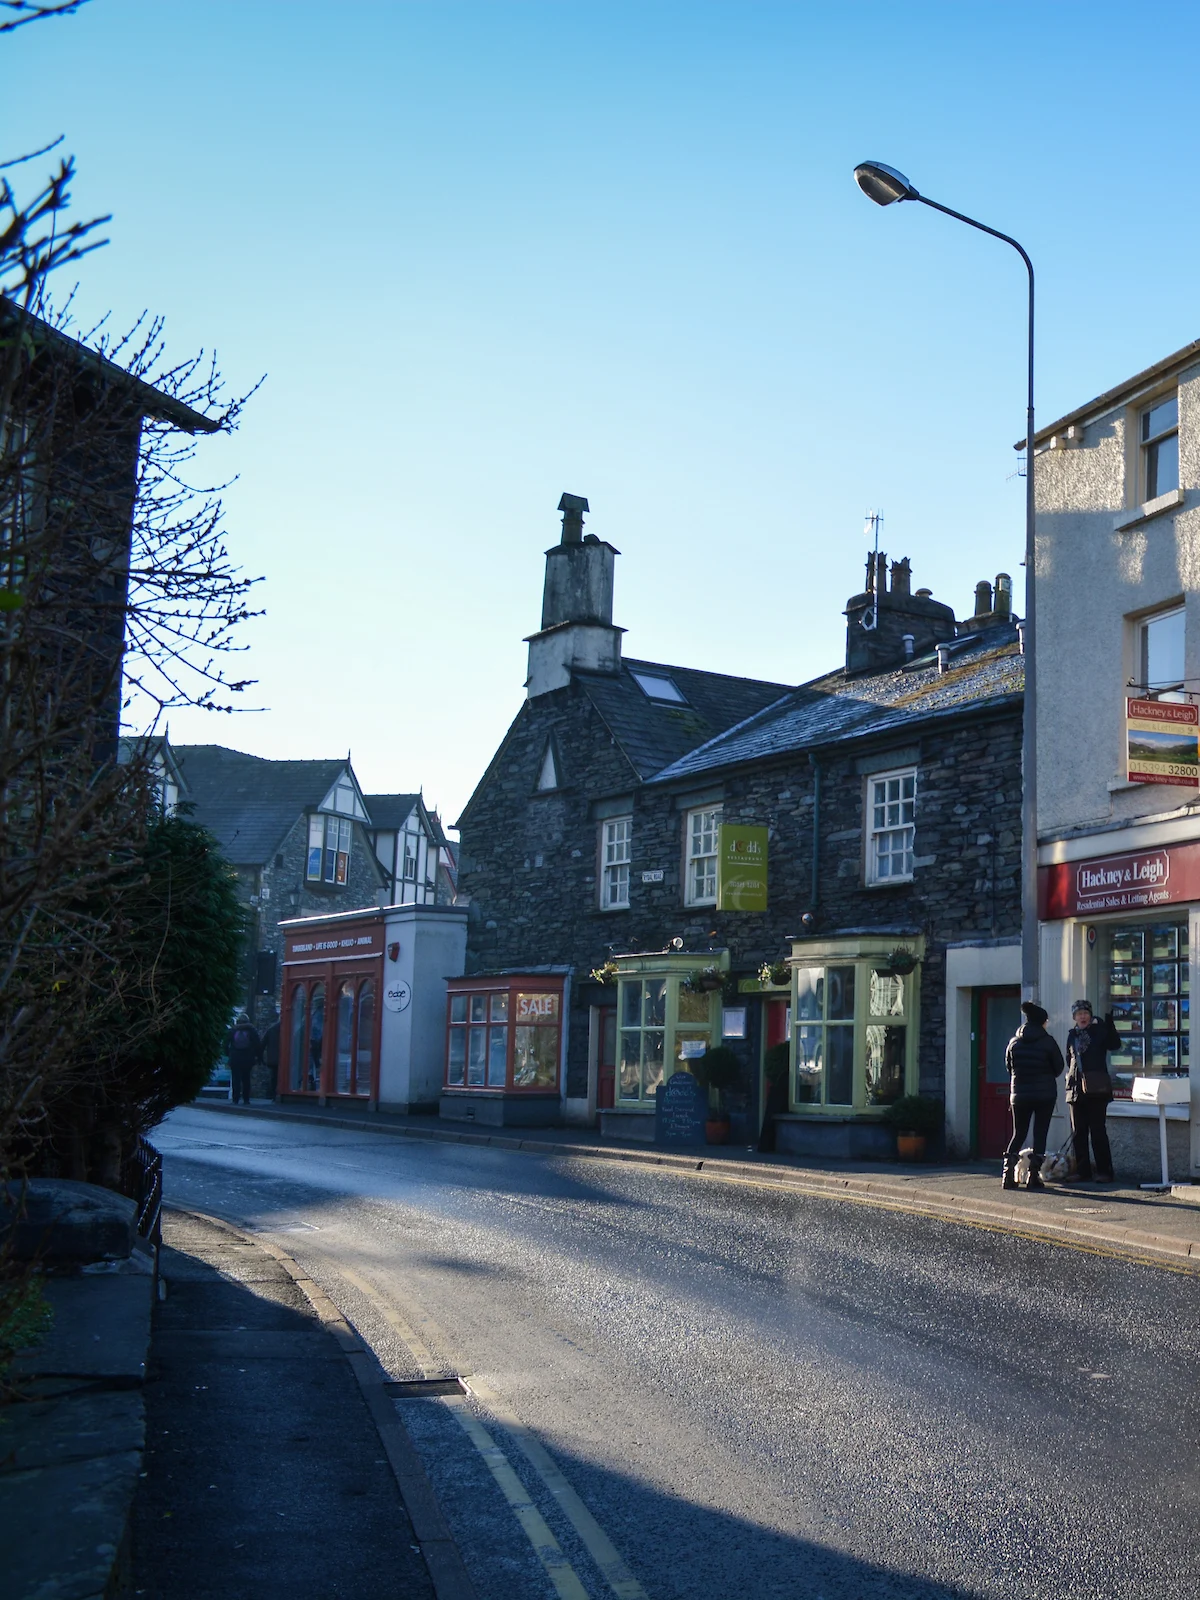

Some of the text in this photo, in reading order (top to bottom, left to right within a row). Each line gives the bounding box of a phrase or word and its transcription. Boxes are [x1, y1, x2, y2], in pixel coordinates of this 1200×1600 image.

[1132, 705, 1166, 718] Hackney
[1173, 709, 1194, 720] Leigh
[1129, 762, 1198, 776] 015394 32800
[1082, 858, 1164, 888] Hackney & Leigh
[1076, 890, 1169, 911] Residential Sales & Letting Agents
[520, 998, 552, 1015] SALE
